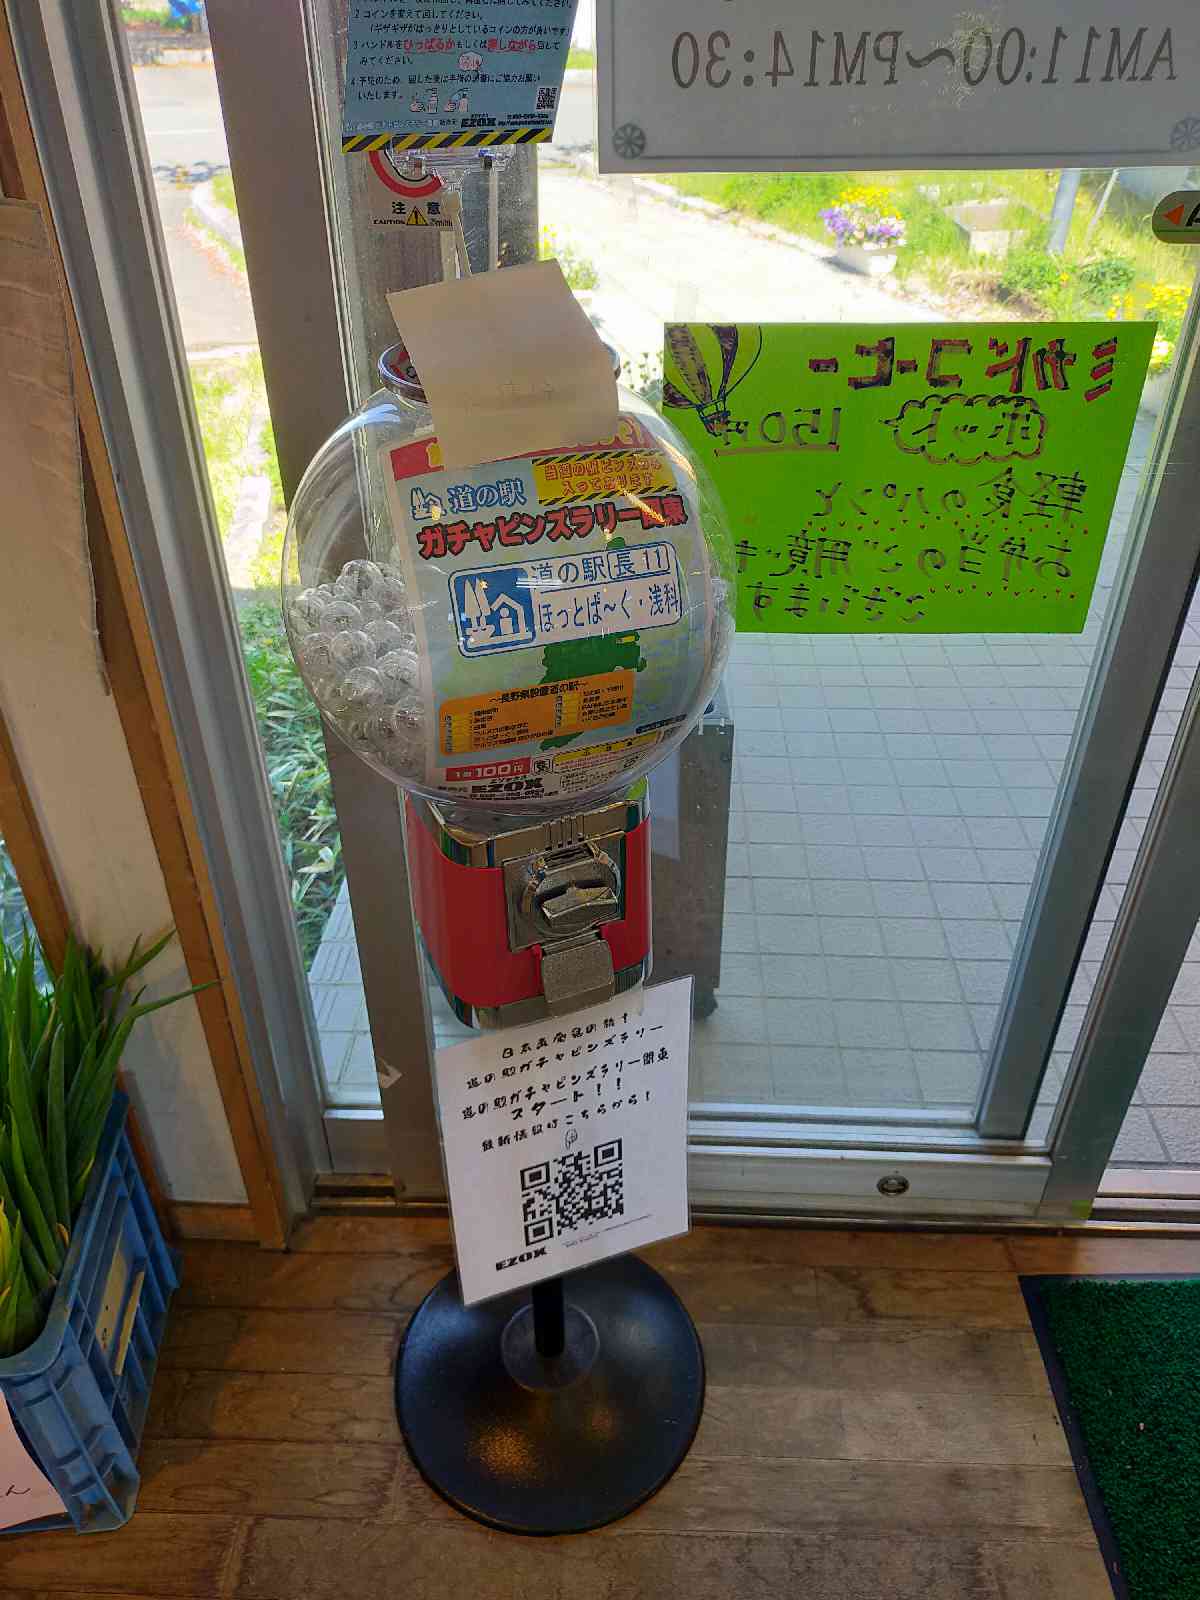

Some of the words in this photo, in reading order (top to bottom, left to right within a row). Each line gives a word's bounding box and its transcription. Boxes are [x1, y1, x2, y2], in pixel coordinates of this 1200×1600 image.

[448, 477, 527, 513] 道の駅
[530, 555, 607, 584] 道の駅
[471, 778, 544, 794] EZOX
[495, 1247, 547, 1271] EZOX
